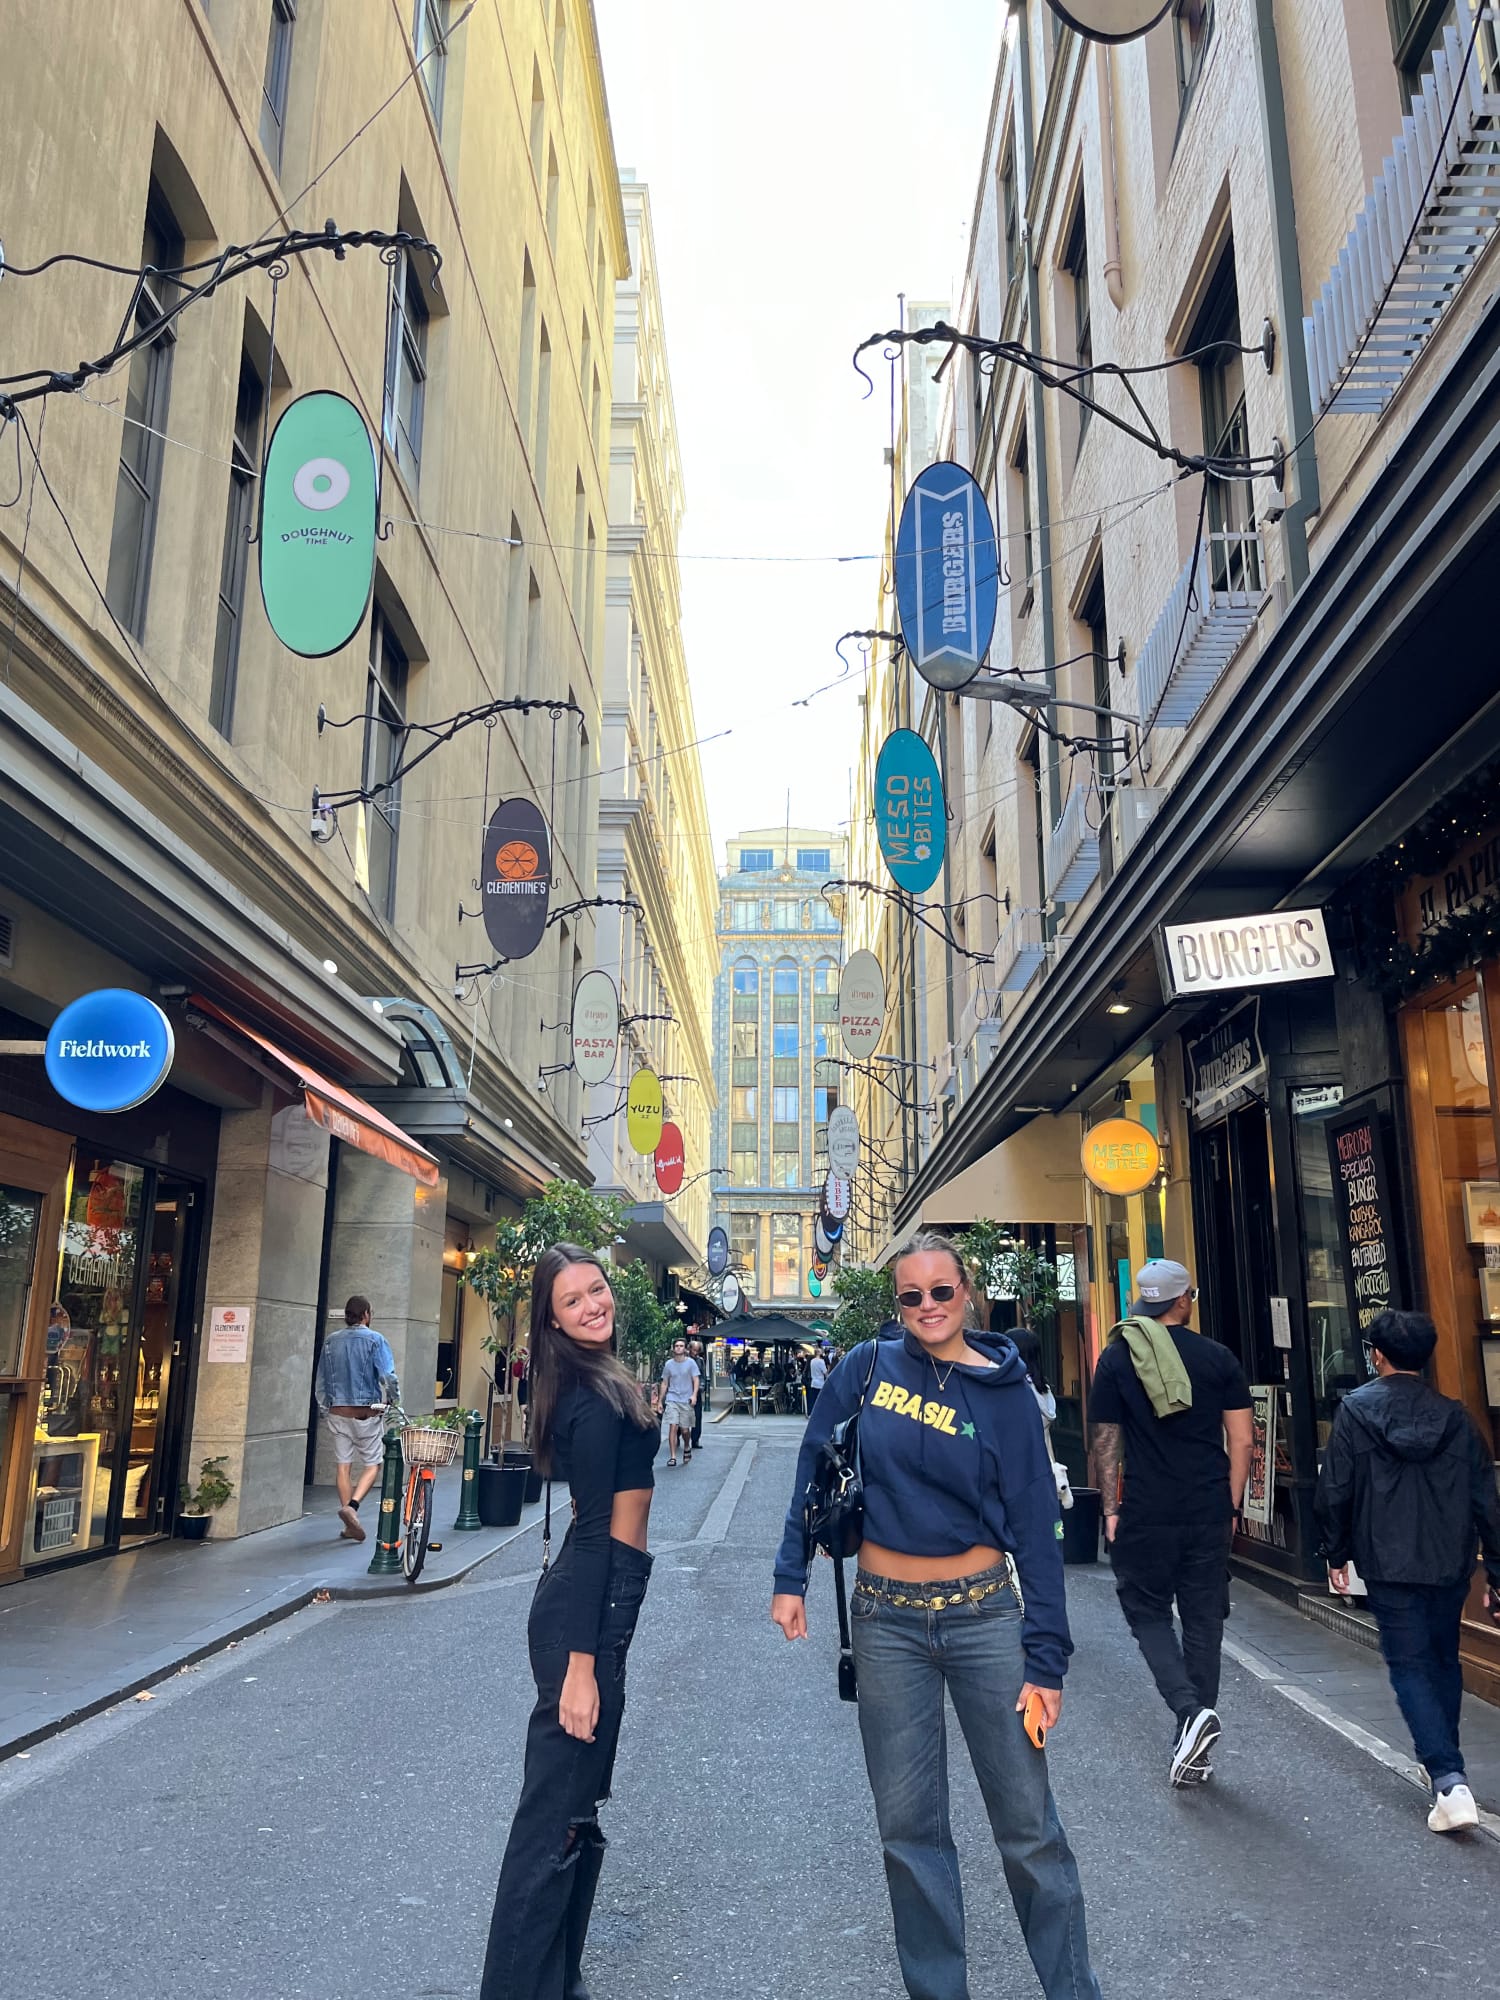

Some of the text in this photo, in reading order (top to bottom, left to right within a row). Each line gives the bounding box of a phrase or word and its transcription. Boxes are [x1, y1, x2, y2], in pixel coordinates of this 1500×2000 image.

[281, 527, 354, 545] DOUGHNUT
[305, 537, 328, 545] TIME
[942, 511, 967, 635] BURGERS
[913, 775, 932, 843] BITES
[886, 775, 920, 865] MESO
[487, 881, 546, 895] CLEMENTINE'S
[1177, 918, 1321, 982] BURGERS
[842, 1016, 880, 1026] PIZZA
[850, 1028, 872, 1036] BAR
[59, 1039, 151, 1057] Fieldwork
[575, 1038, 615, 1048] PASTA
[584, 1050, 605, 1058] BAR
[630, 1105, 660, 1114] YUZU
[1093, 1143, 1148, 1165] MESO
[1106, 1158, 1149, 1170] BITES
[1348, 1175, 1379, 1206] BURGER
[1350, 1204, 1378, 1223] OUTBACK
[870, 1380, 958, 1436] BRASIL
